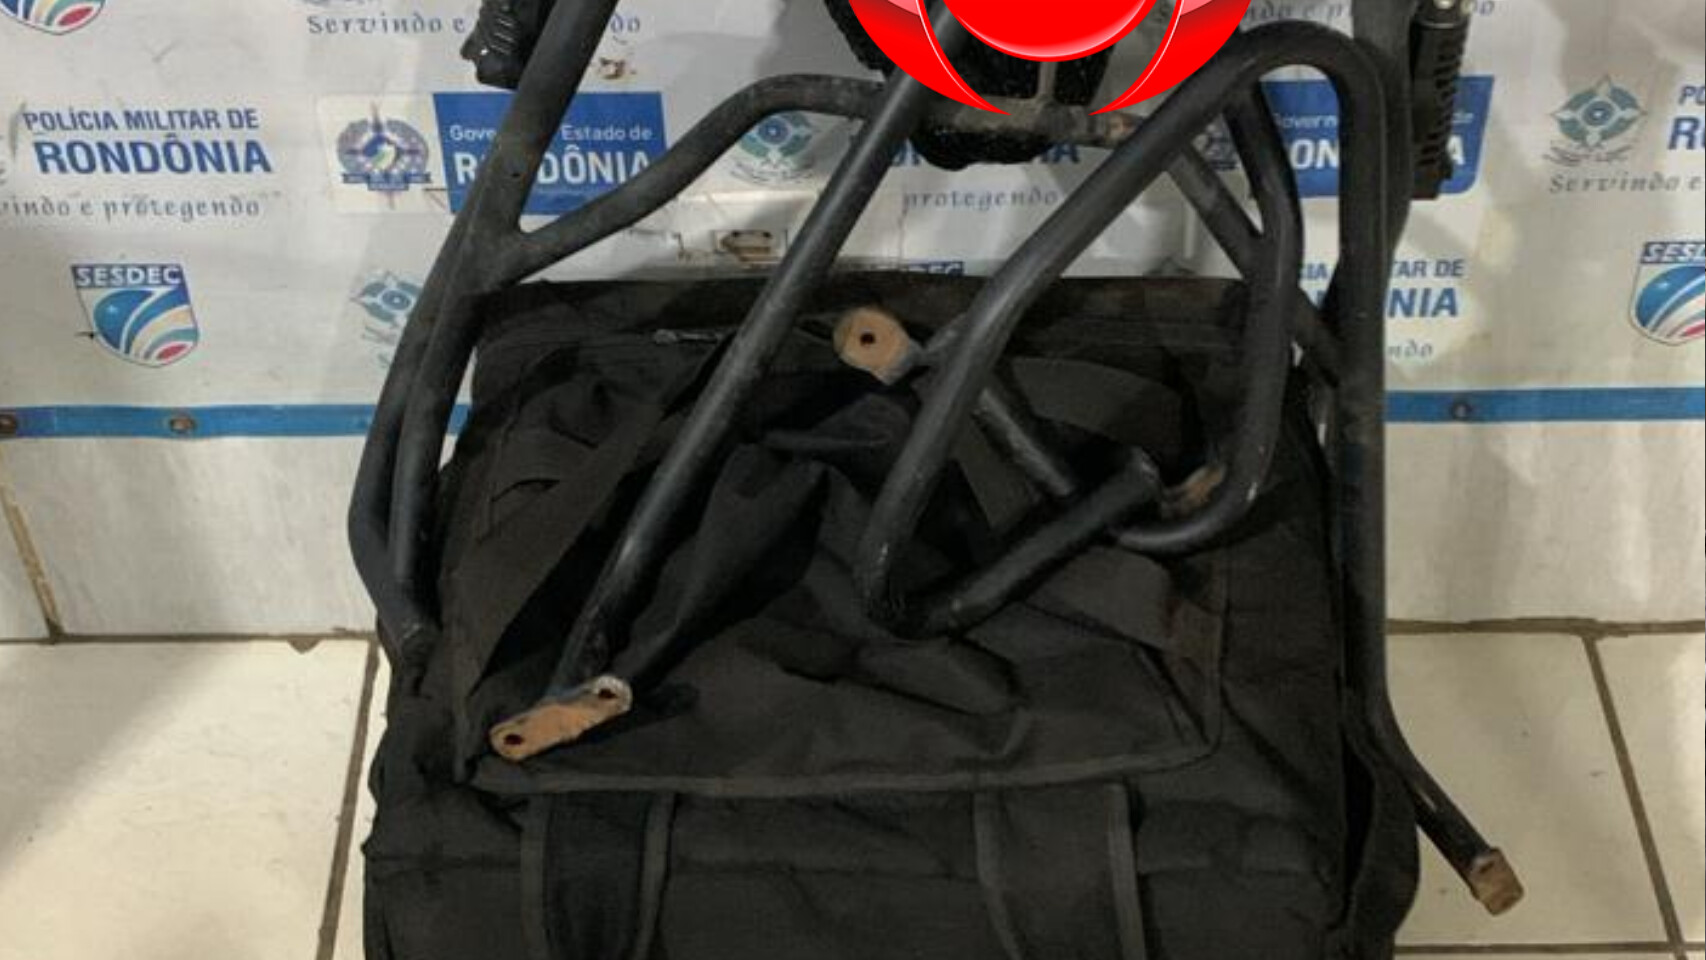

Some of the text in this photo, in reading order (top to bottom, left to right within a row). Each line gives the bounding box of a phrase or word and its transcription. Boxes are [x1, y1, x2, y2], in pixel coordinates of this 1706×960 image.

[308, 11, 442, 35] Servindo
[23, 106, 260, 132] POLÍCIA MILITAR DE
[450, 123, 652, 142] Gove Estado de
[33, 132, 272, 175] RONDÔNIA
[454, 144, 652, 186] RDÔNIA
[76, 266, 182, 287] SESDEC
